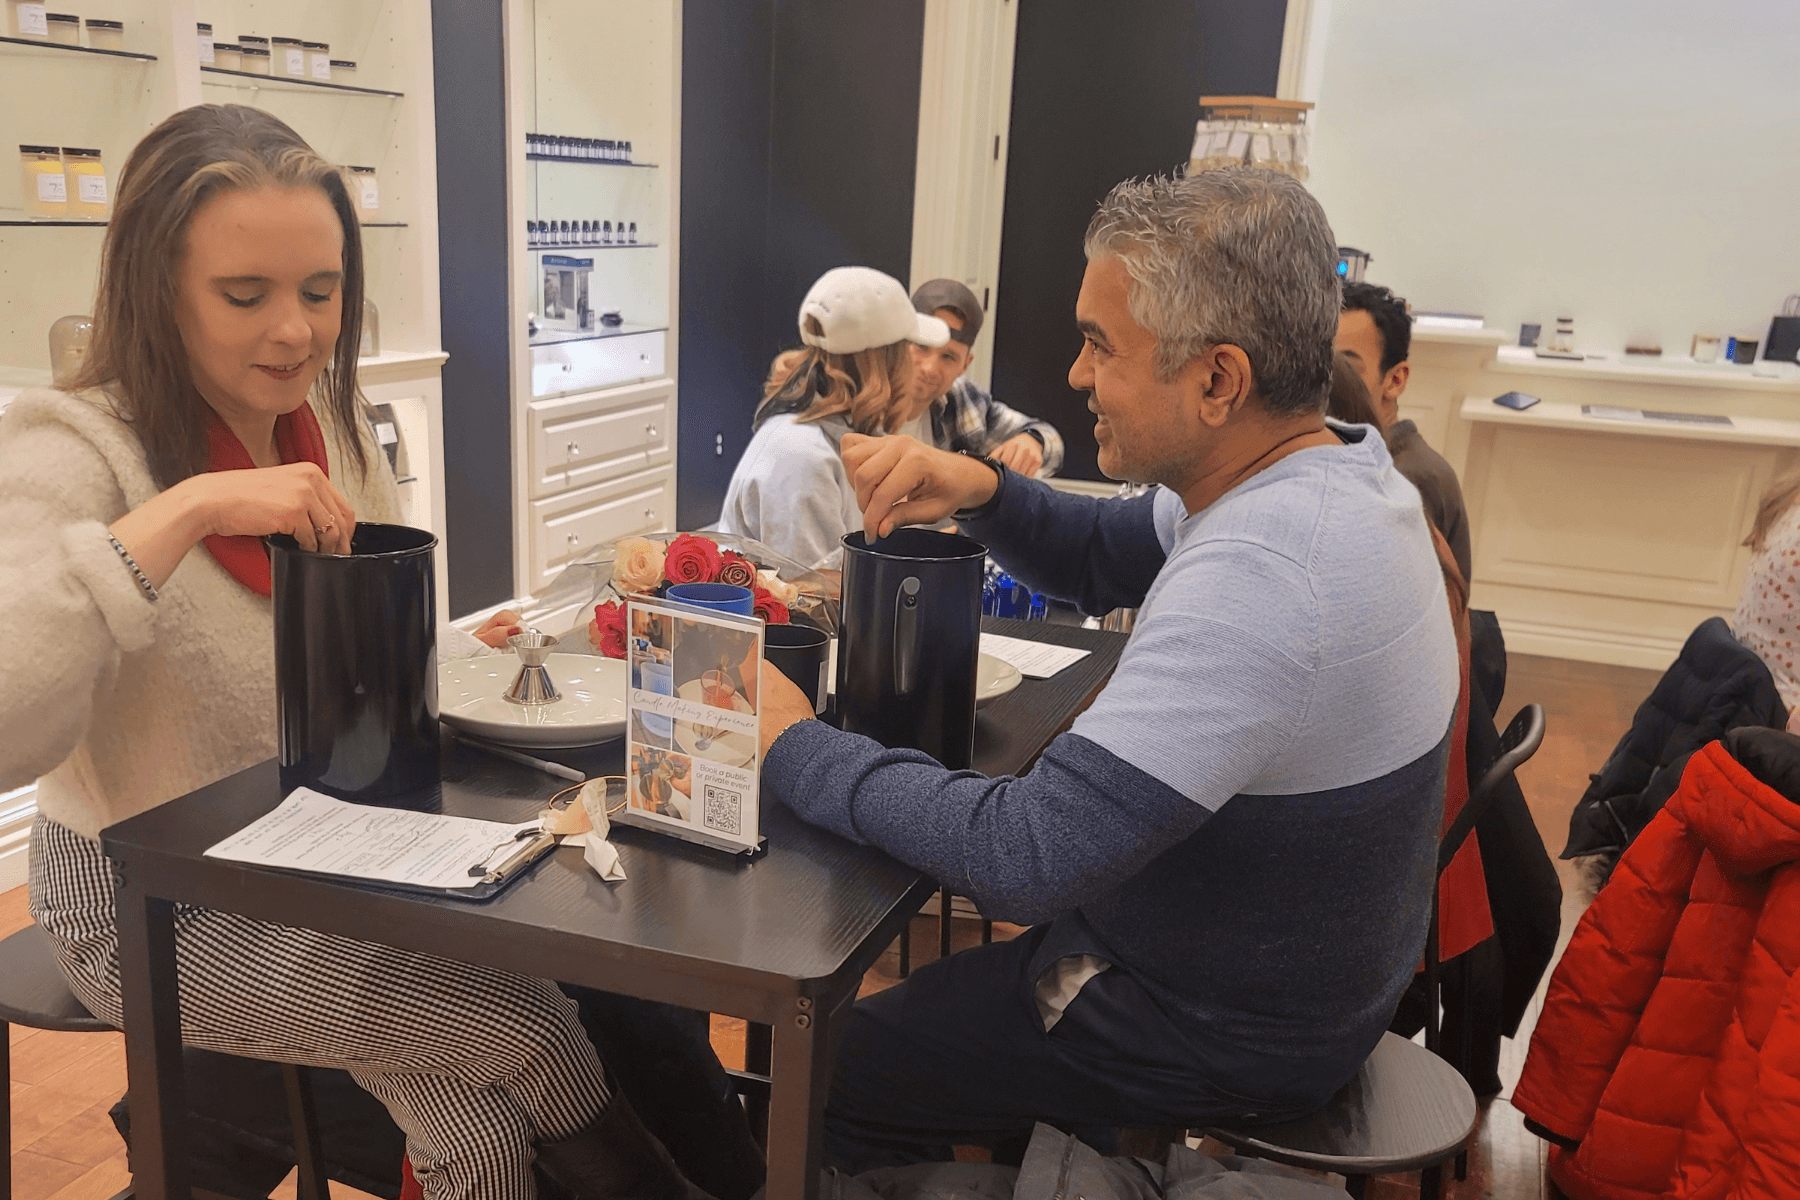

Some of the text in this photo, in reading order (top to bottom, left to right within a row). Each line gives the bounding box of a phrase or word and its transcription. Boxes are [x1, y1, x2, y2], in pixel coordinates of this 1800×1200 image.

[667, 700, 702, 719] Making
[700, 764, 718, 774] Book
[725, 771, 748, 782] public
[705, 774, 730, 785] private
[730, 781, 751, 791] event
